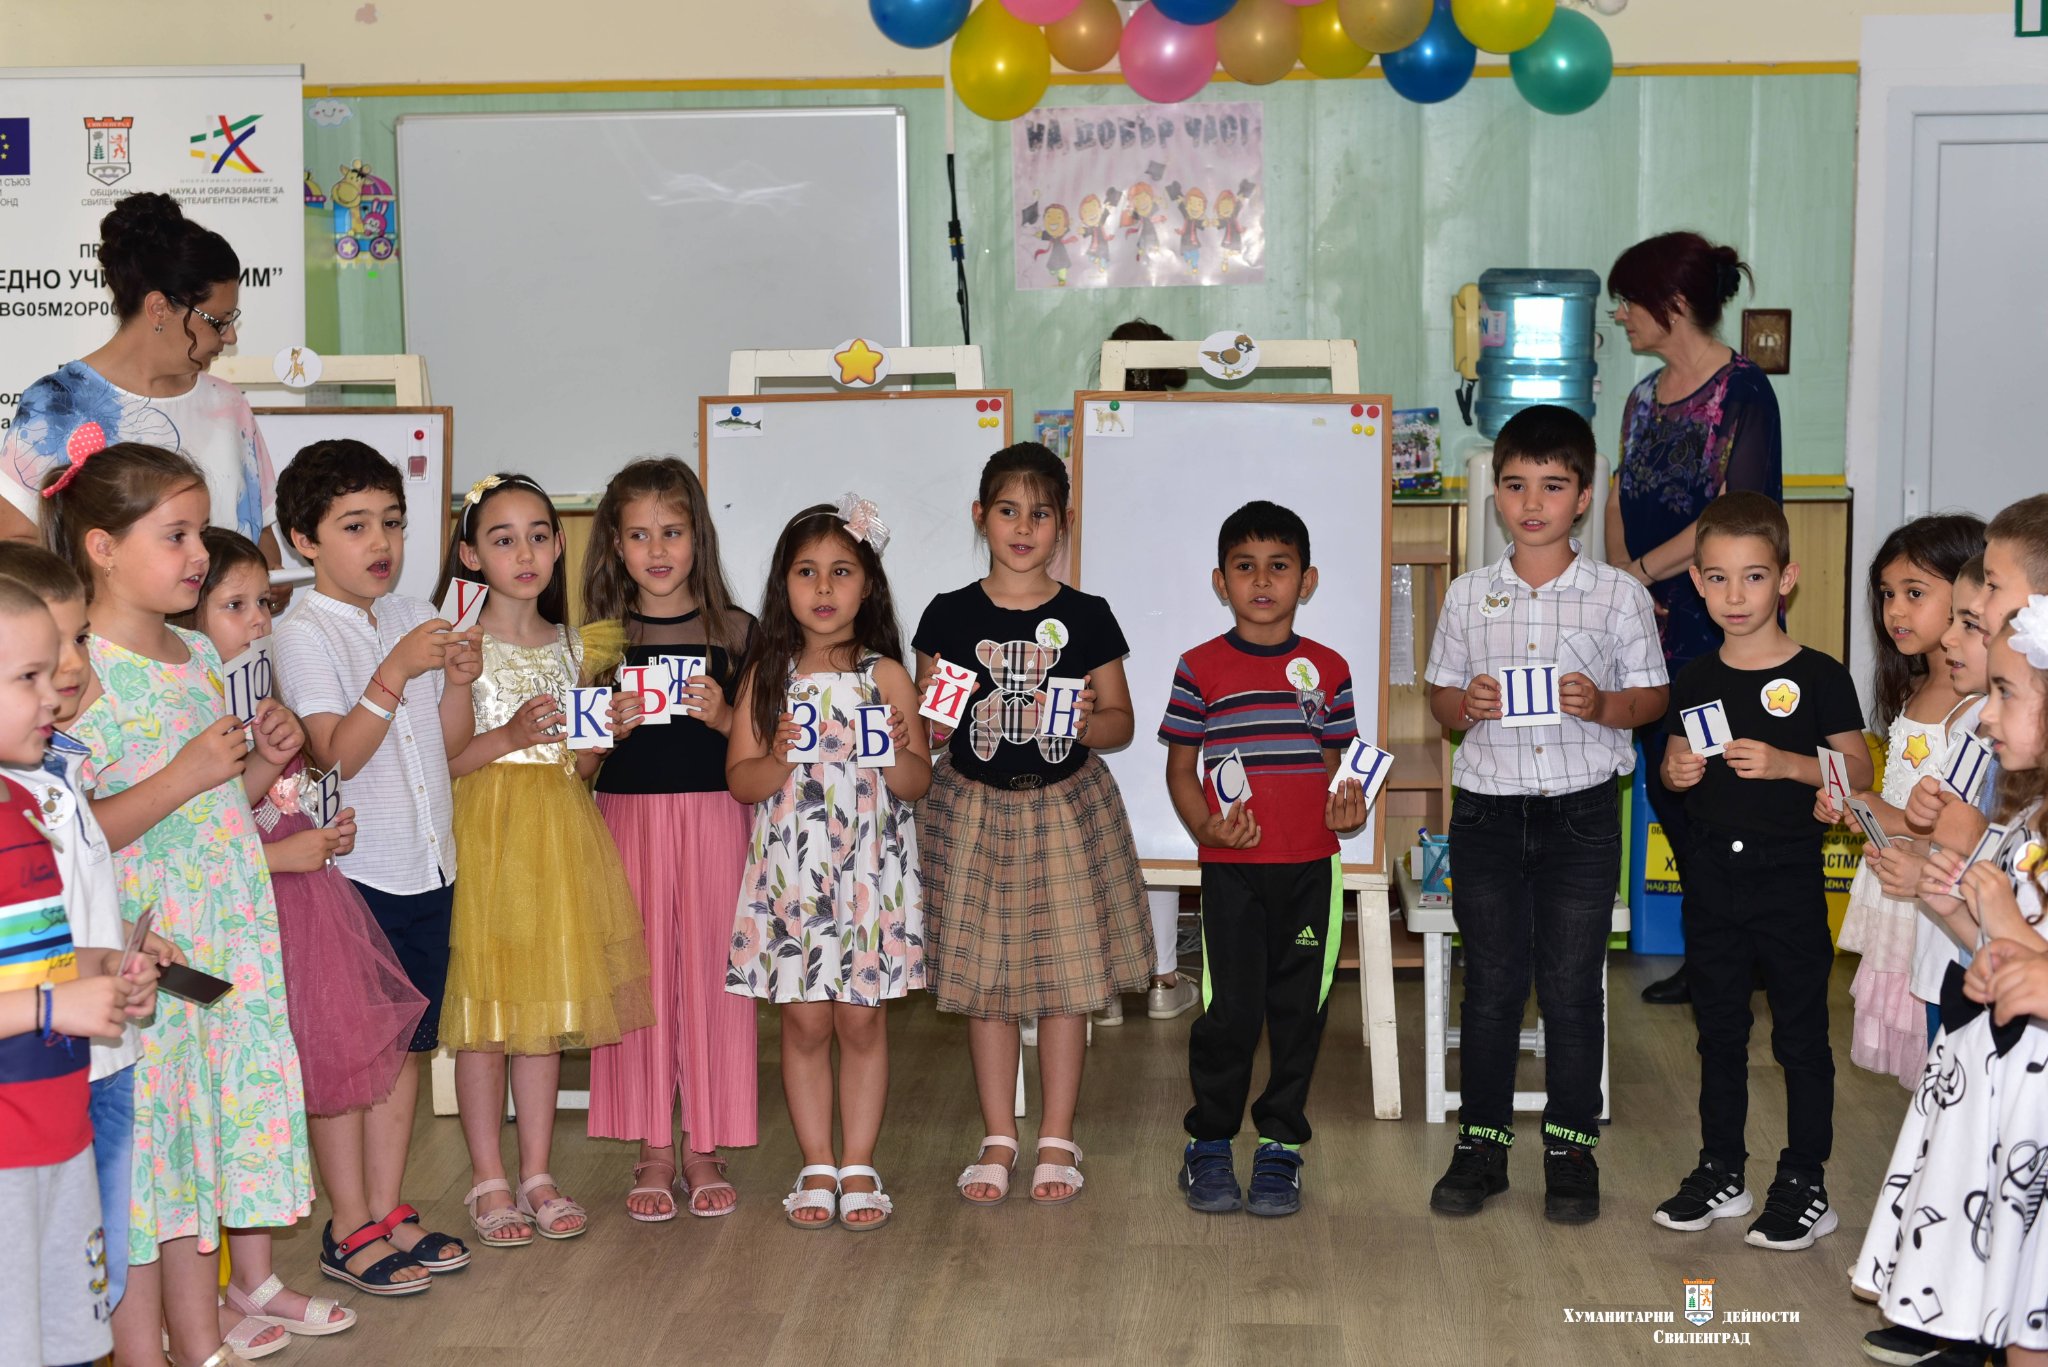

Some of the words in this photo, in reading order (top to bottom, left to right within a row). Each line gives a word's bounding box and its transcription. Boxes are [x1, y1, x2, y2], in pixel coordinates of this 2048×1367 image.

[1026, 118, 1064, 151] НА
[1073, 114, 1174, 151] ДОБЪР
[207, 187, 271, 195] ОБРАЗОВАНИЕ
[242, 196, 279, 204] РАСТЕЖ
[453, 579, 487, 628] У
[253, 649, 271, 701] Ф
[623, 667, 667, 715] Ъ
[925, 665, 969, 720] Й
[1502, 667, 1558, 717] Ш
[568, 688, 610, 738] К
[854, 706, 890, 758] Б
[1044, 687, 1082, 737] Н
[1682, 703, 1721, 750] Т
[1216, 753, 1246, 804] С
[1350, 739, 1391, 799] Ч
[1827, 752, 1846, 798] А
[319, 769, 341, 828] В
[1295, 937, 1319, 946] adidas
[1468, 1124, 1498, 1140] WHITE
[1545, 1121, 1576, 1141] WHITE
